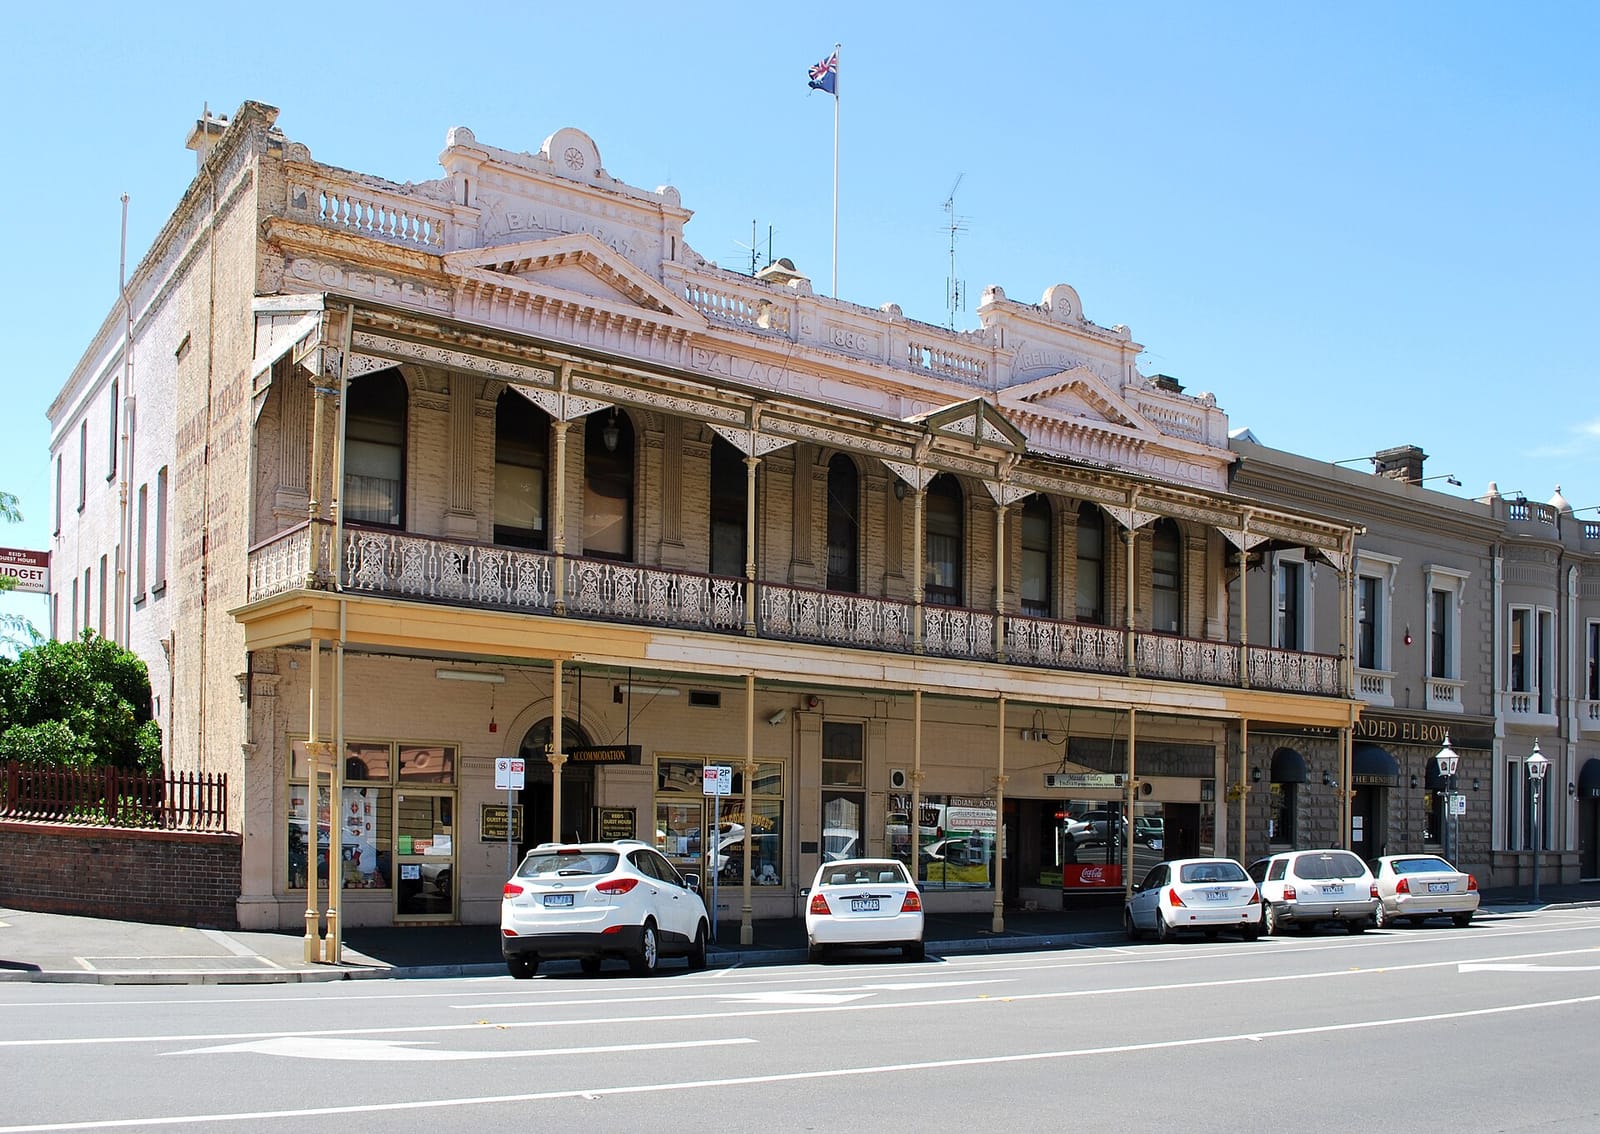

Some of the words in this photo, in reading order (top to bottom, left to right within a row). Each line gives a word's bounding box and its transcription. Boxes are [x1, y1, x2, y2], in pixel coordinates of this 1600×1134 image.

[290, 257, 449, 313] COFFEE
[828, 326, 870, 352] 1886
[691, 347, 809, 394] PALACE
[1402, 722, 1452, 742] ELBOW
[573, 750, 626, 761] ACCOMMODATION
[719, 769, 730, 777] 2P
[894, 797, 937, 810] Maala
